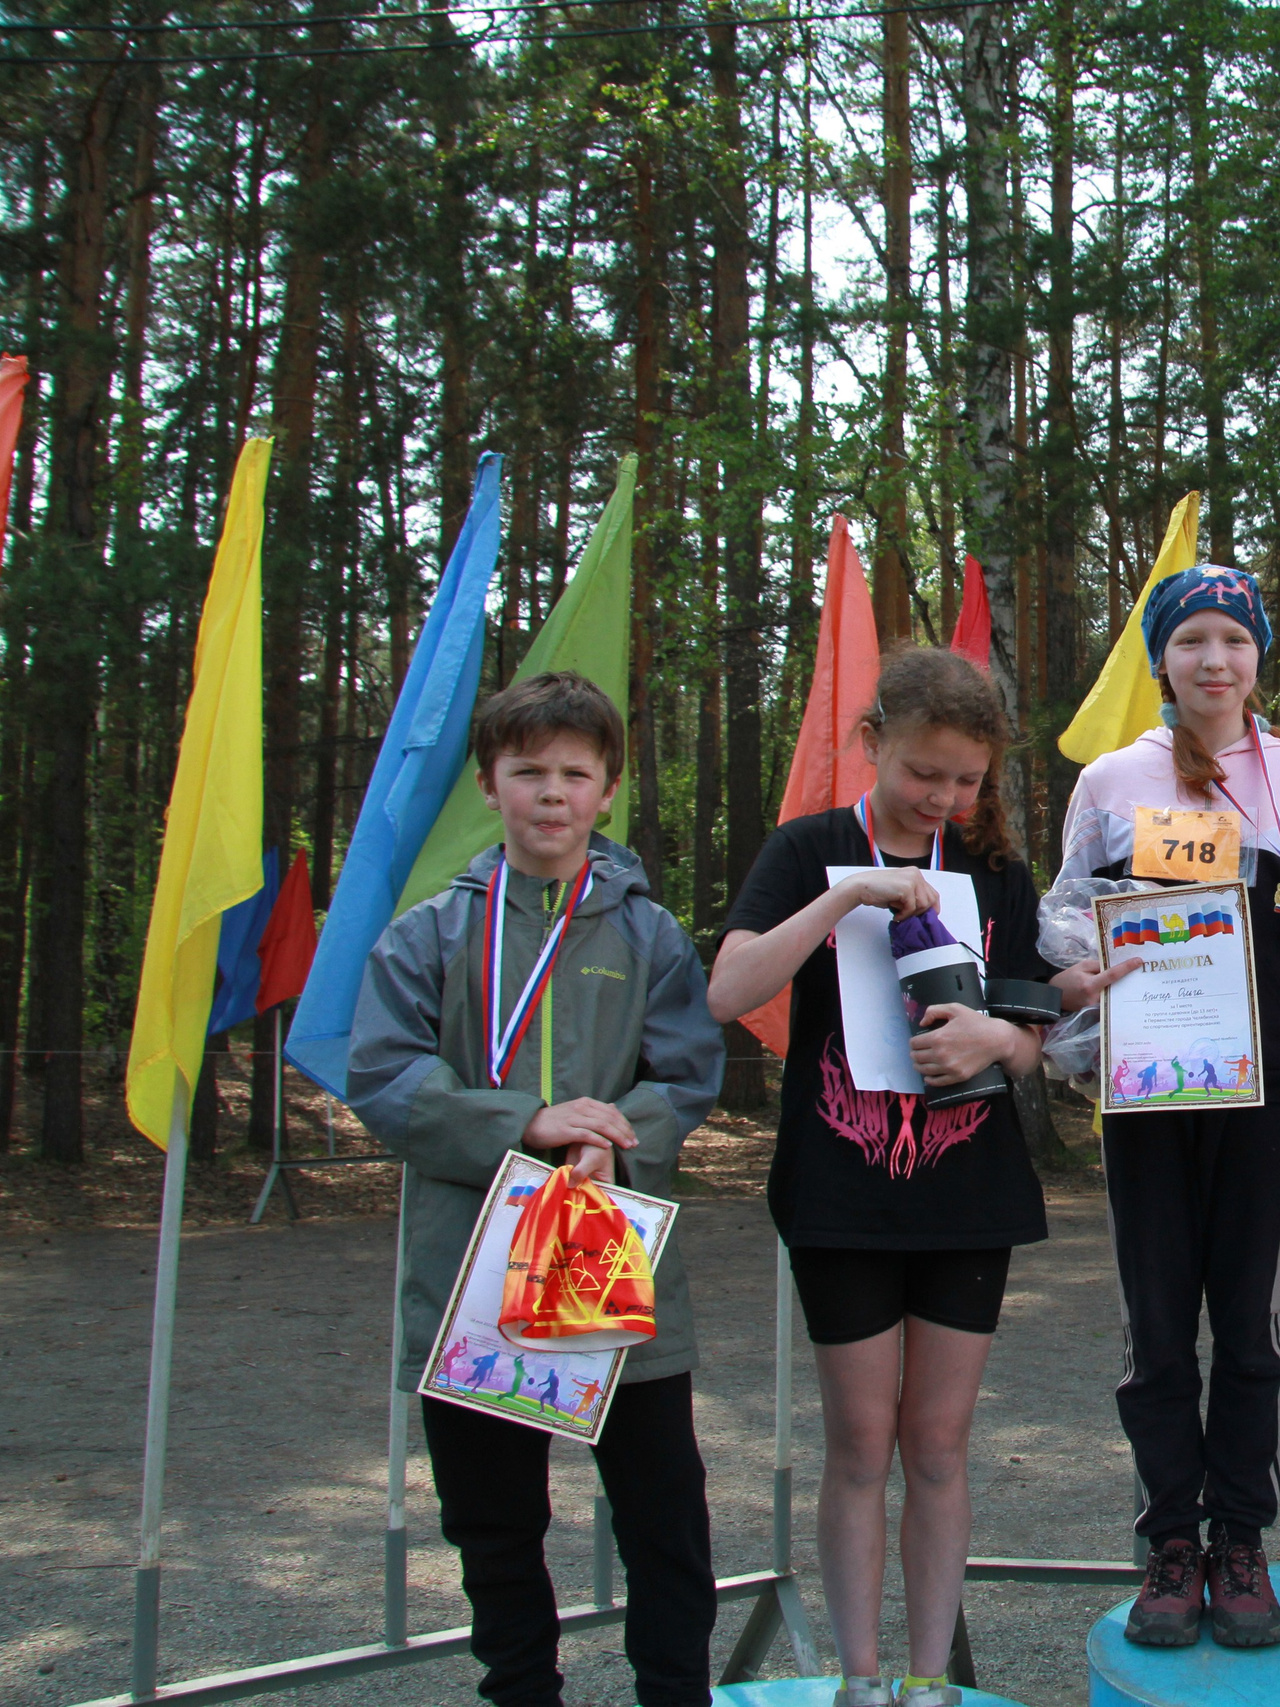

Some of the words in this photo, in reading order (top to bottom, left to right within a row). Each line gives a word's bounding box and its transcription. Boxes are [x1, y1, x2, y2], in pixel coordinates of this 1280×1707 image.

[1163, 839, 1216, 864] 718
[1142, 955, 1213, 973] ГРАМОТА
[590, 966, 626, 981] Columbia
[1178, 987, 1204, 997] Ольга
